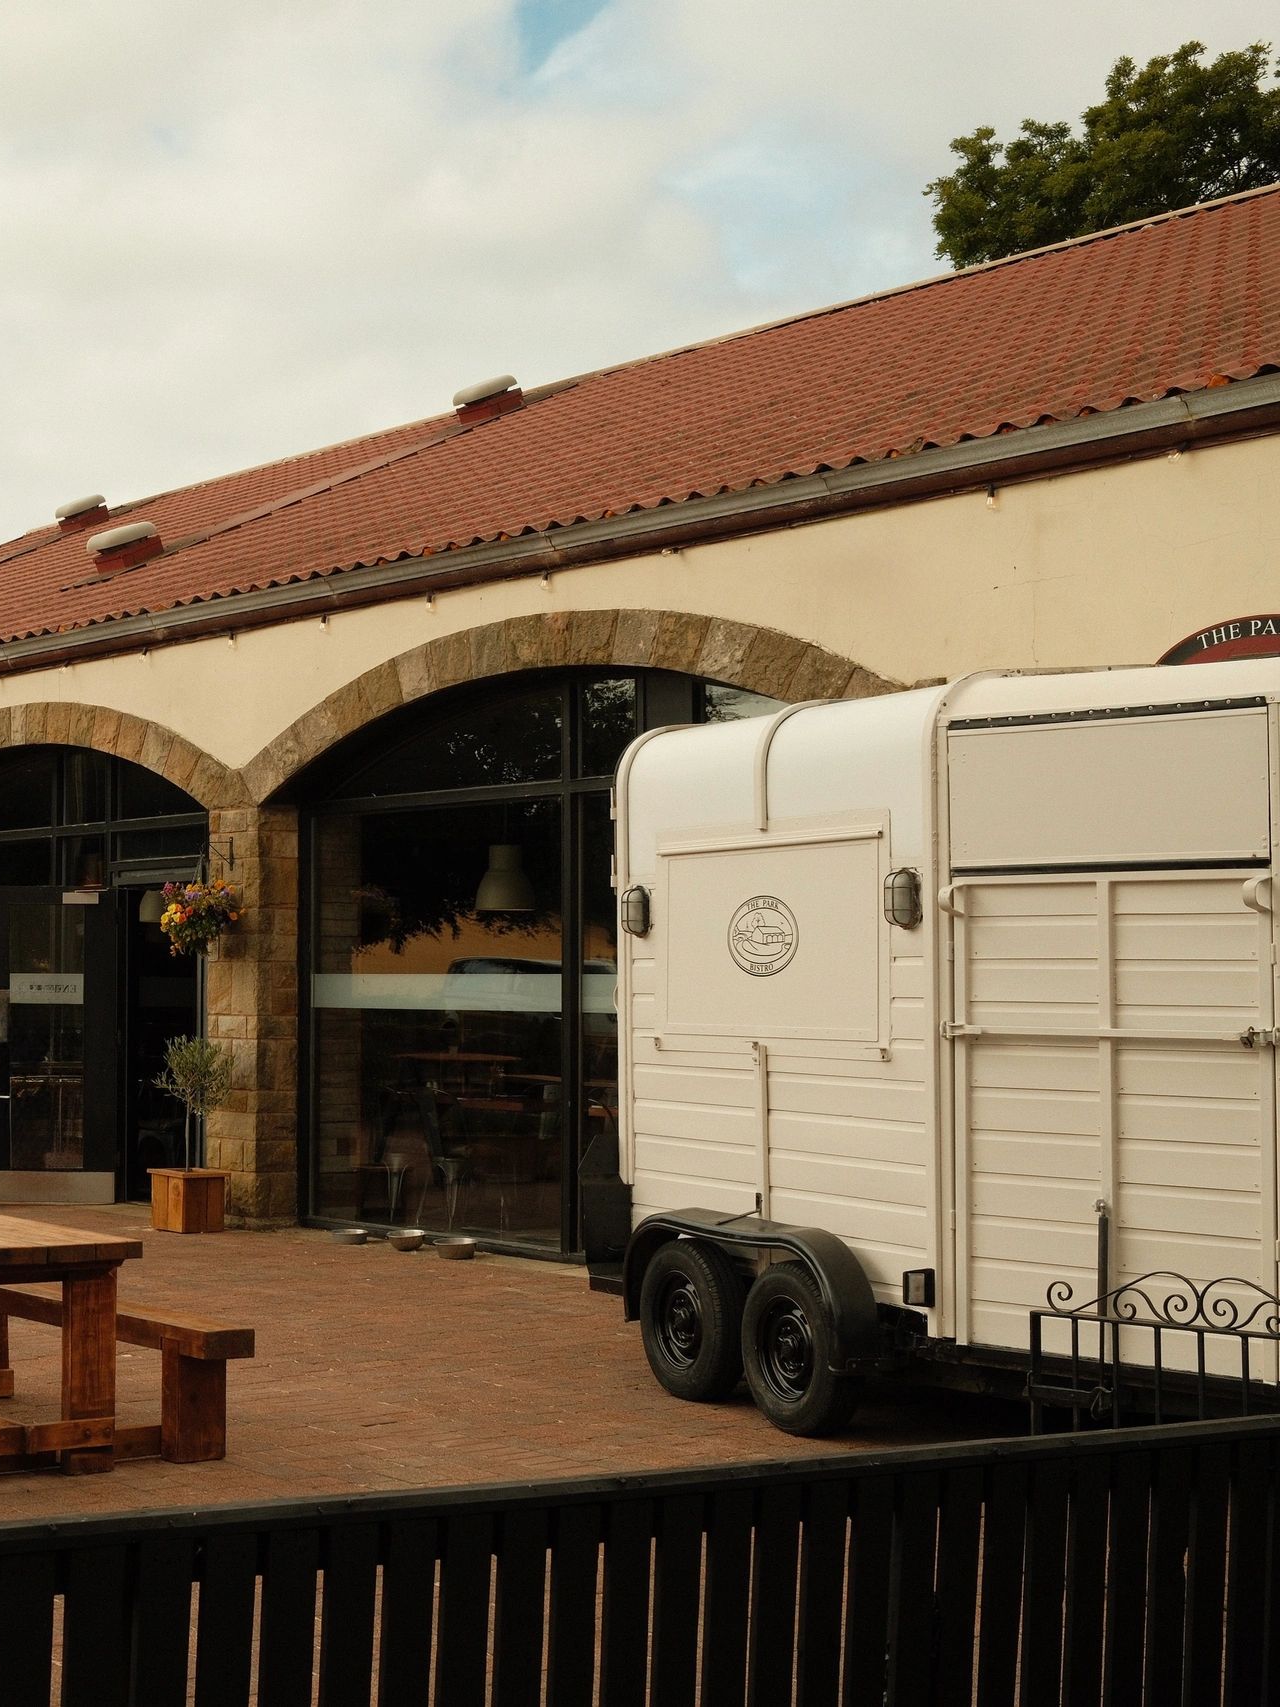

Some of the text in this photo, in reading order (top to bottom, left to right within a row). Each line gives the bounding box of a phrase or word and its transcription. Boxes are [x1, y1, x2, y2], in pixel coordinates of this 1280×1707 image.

[1197, 619, 1280, 650] THE PA
[746, 899, 779, 911] THE PARK
[749, 963, 774, 972] BISTRO
